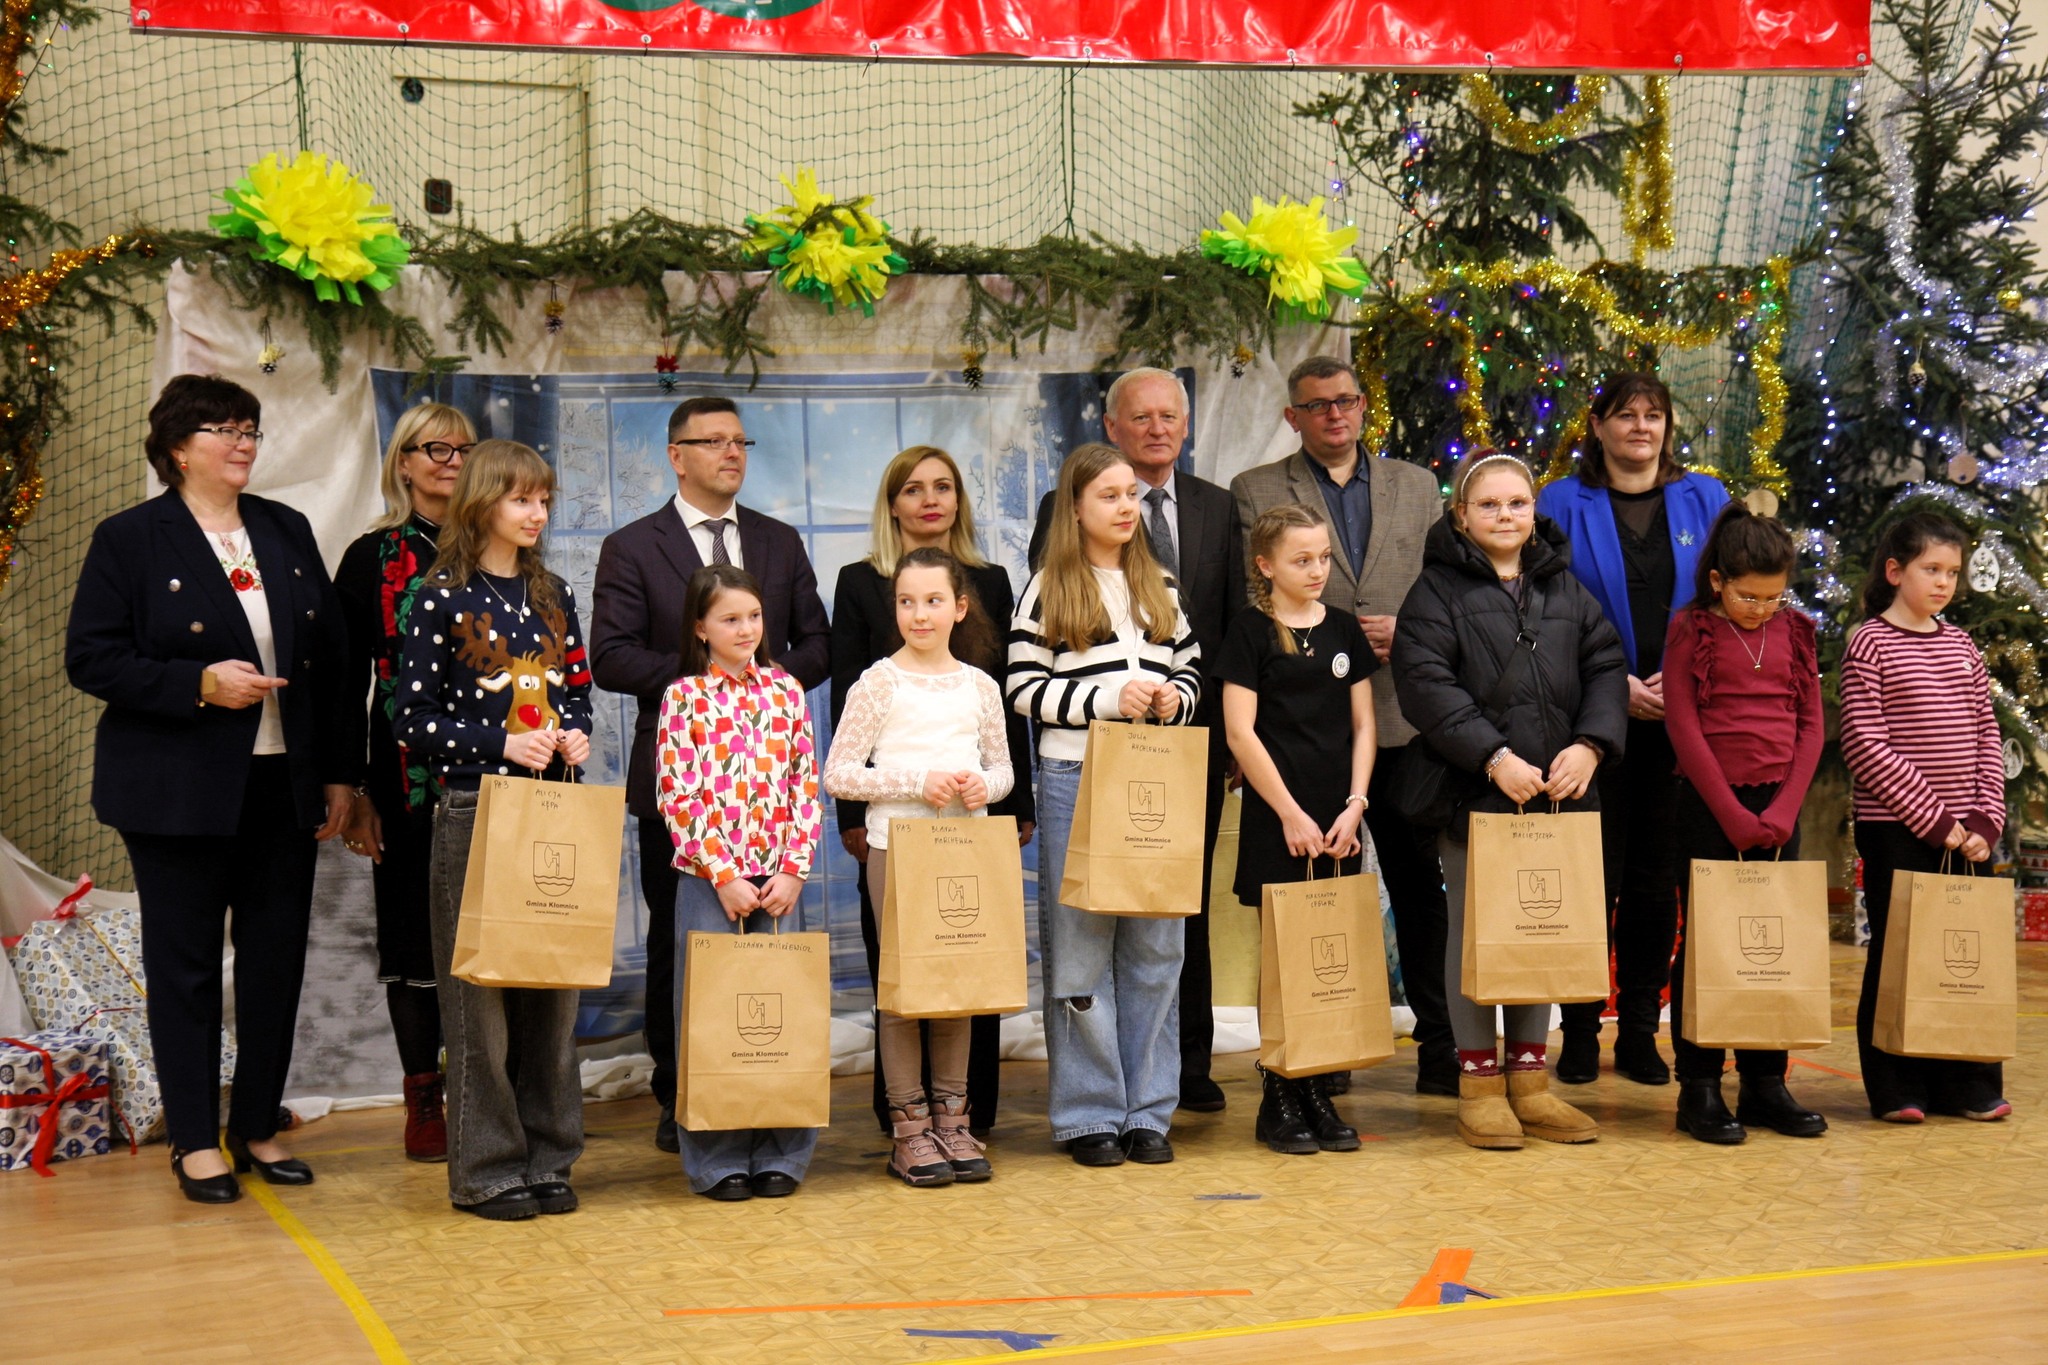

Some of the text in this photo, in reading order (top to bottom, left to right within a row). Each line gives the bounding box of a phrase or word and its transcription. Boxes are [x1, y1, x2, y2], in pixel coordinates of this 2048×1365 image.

[535, 788, 562, 800] ALICJA
[1510, 821, 1535, 832] ALICJA
[525, 900, 547, 908] Gmina
[934, 933, 956, 941] Gmina
[1311, 990, 1329, 998] Gmina
